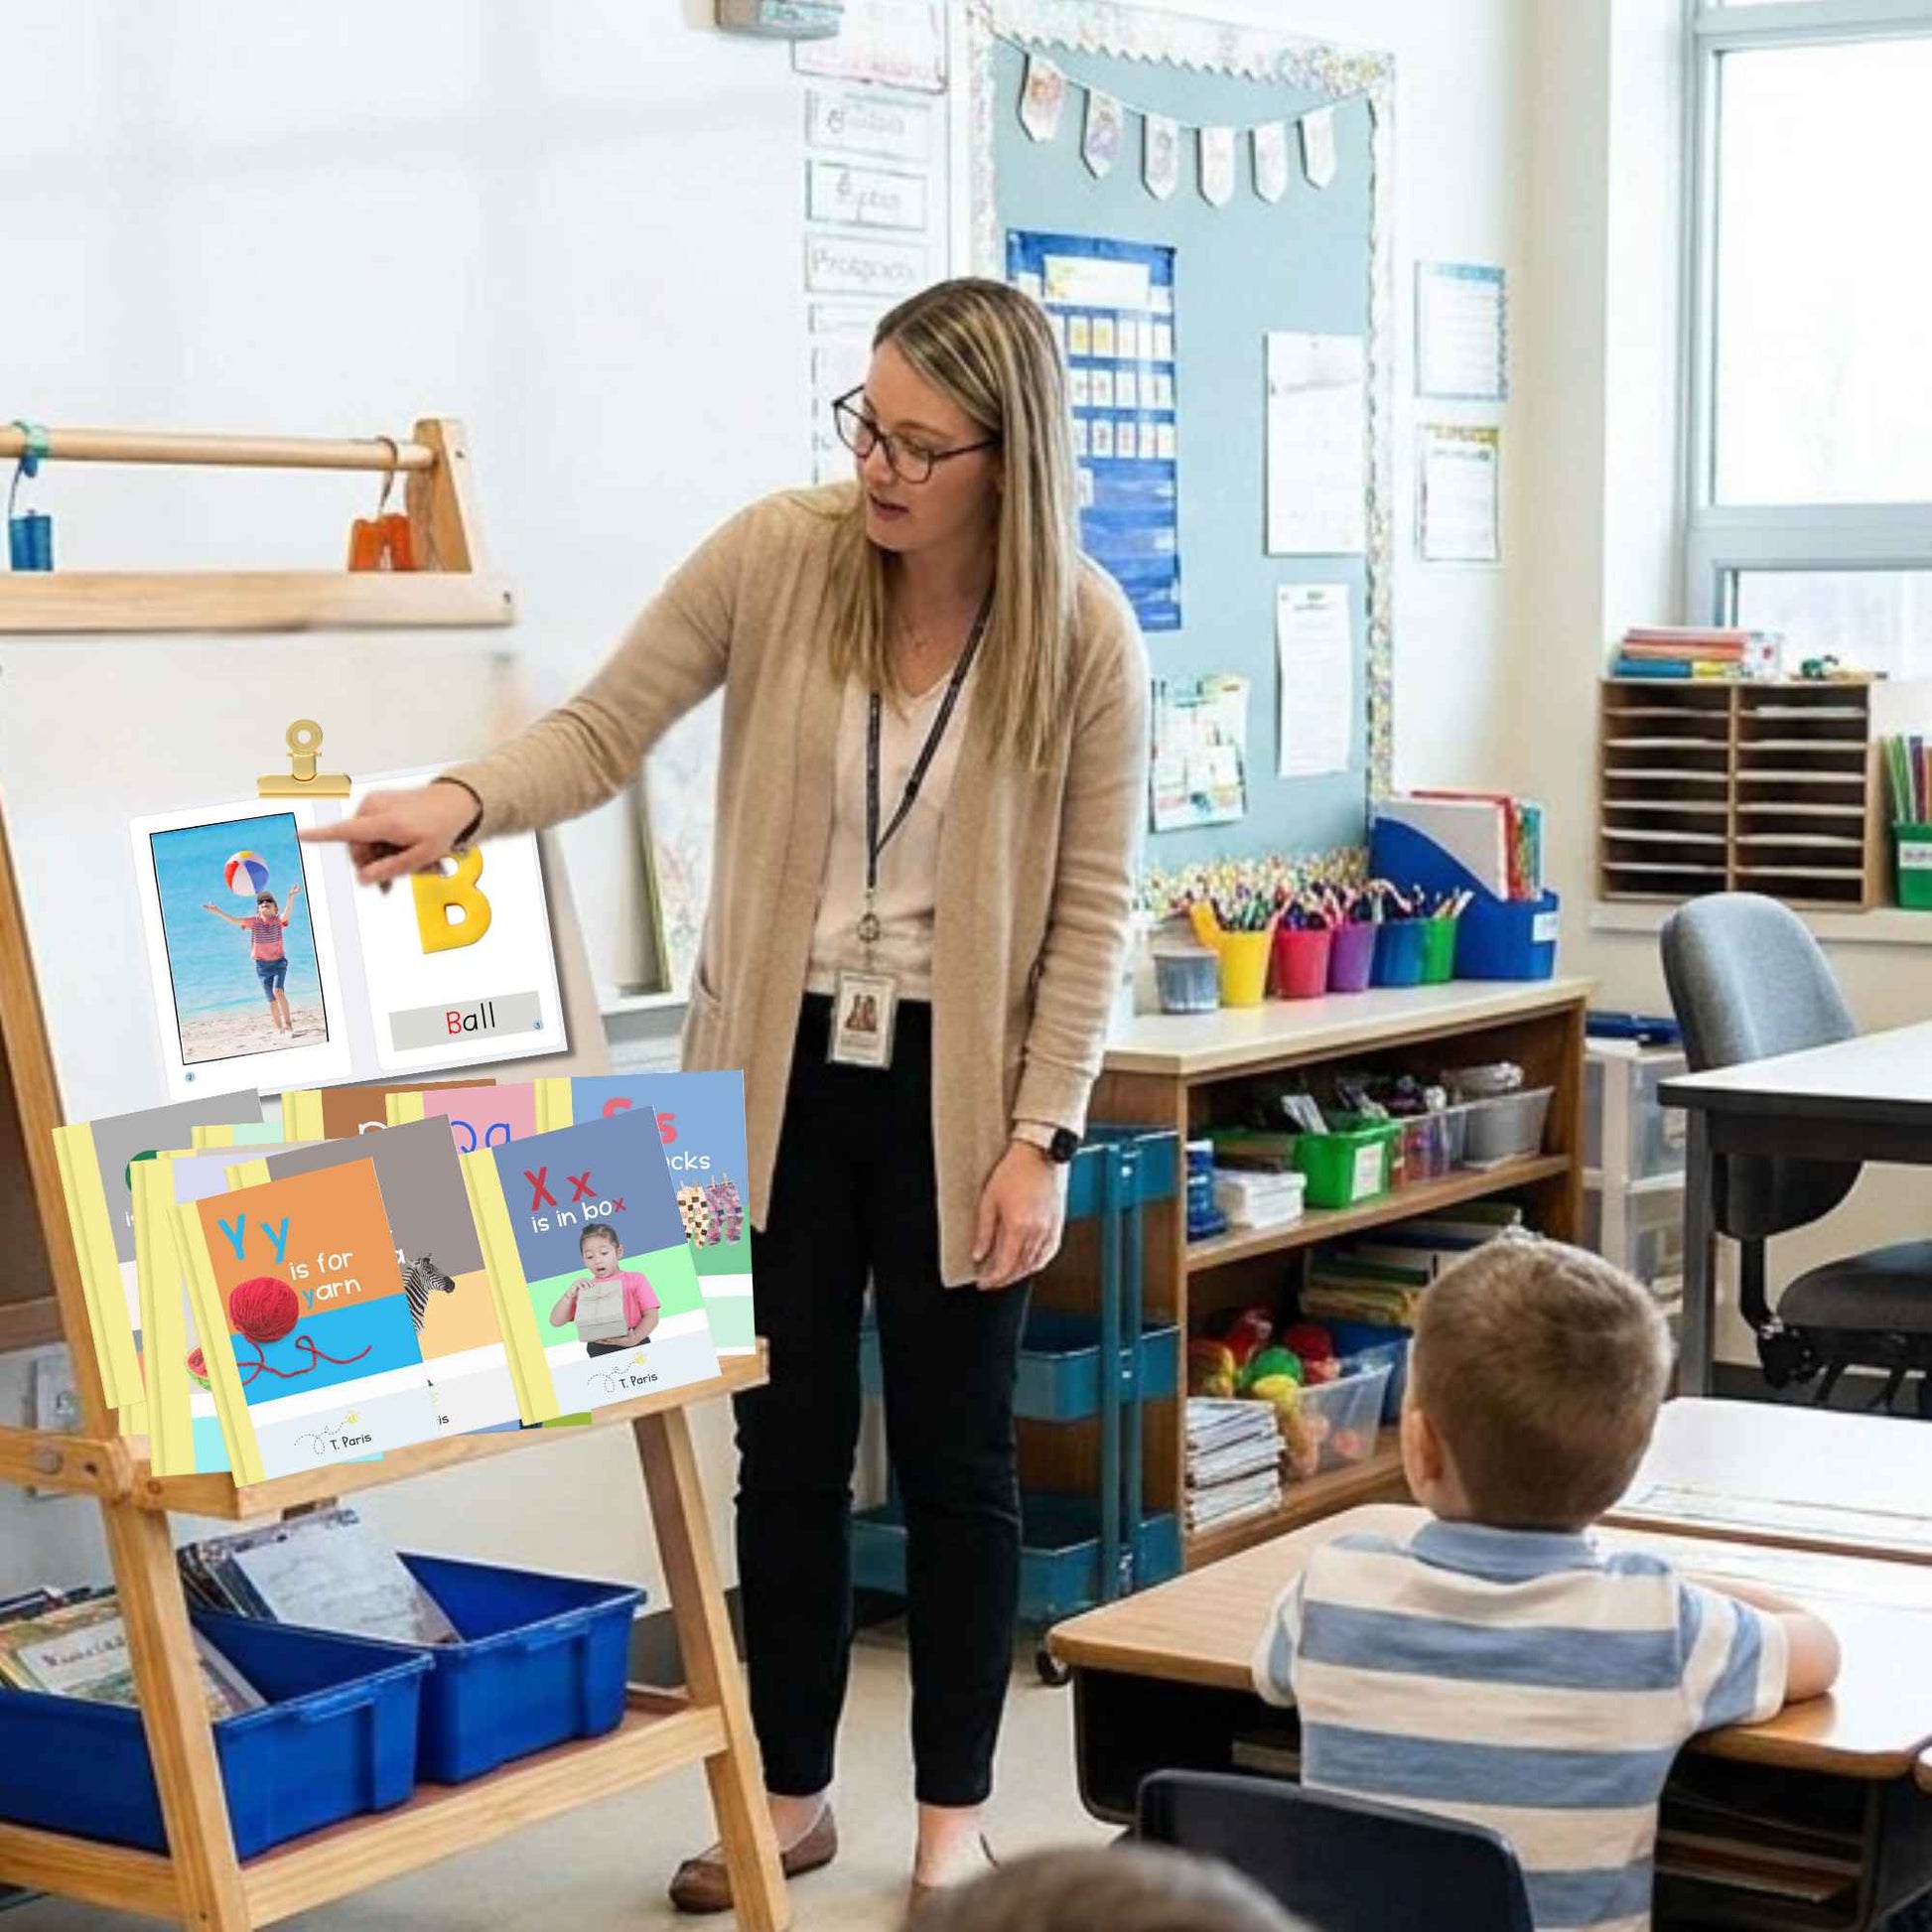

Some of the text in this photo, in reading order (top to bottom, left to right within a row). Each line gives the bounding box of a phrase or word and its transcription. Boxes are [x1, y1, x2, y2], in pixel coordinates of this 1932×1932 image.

[409, 843, 492, 955] B
[446, 1001, 495, 1035] Ball
[666, 1151, 711, 1171] cks
[523, 1166, 598, 1211] X x
[531, 1197, 626, 1233] is in box
[216, 1213, 290, 1265] Y y
[289, 1252, 353, 1281] is for
[302, 1278, 361, 1310] yarn
[619, 1373, 658, 1389] T. Paris
[330, 1433, 372, 1450] T. Paris
